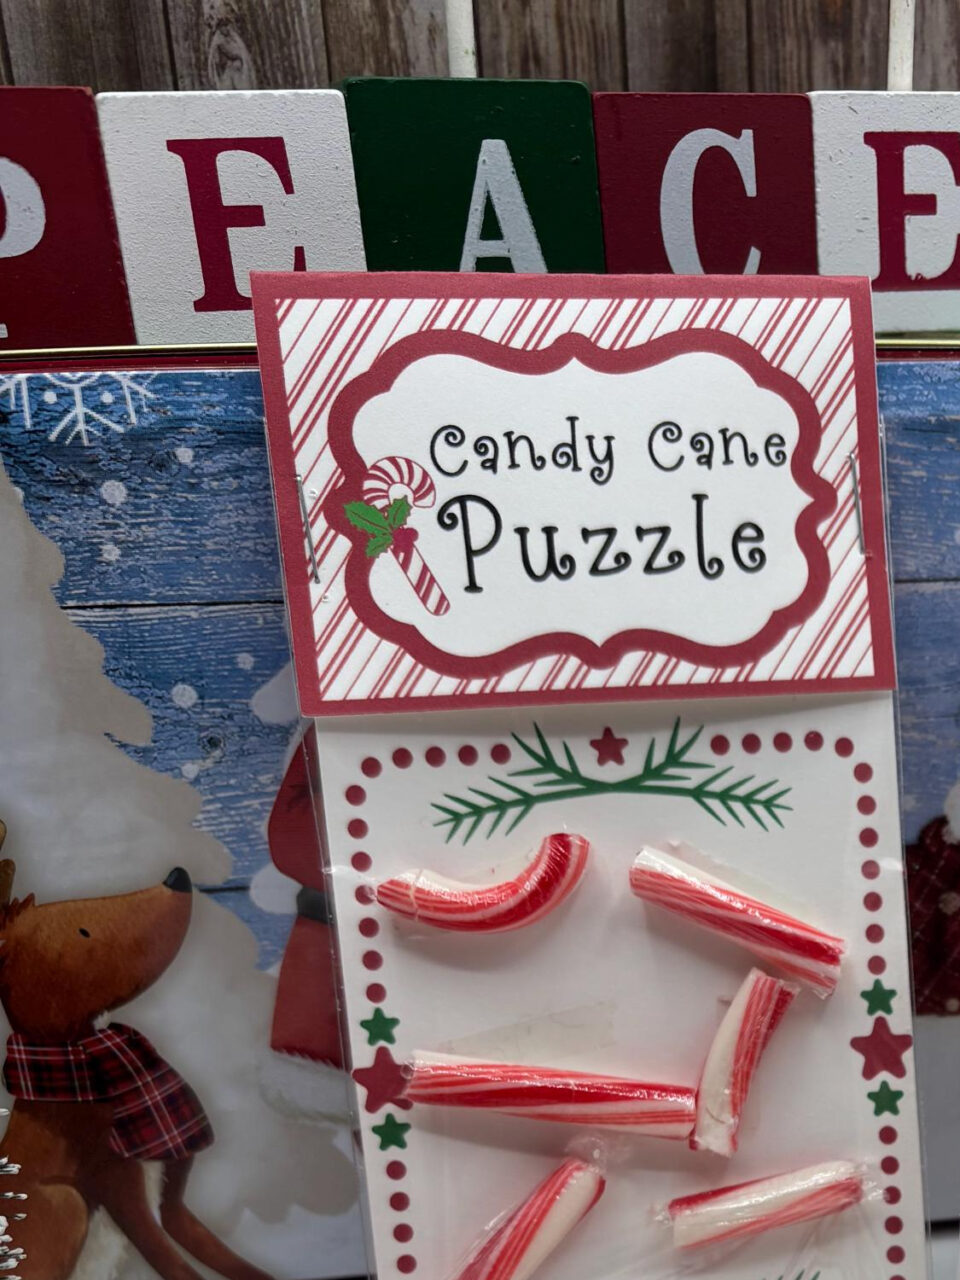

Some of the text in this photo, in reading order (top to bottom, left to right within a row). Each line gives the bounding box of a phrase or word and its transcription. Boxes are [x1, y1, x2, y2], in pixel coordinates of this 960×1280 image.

[429, 416, 787, 486] Candy Cane
[436, 493, 767, 593] Puzzle
